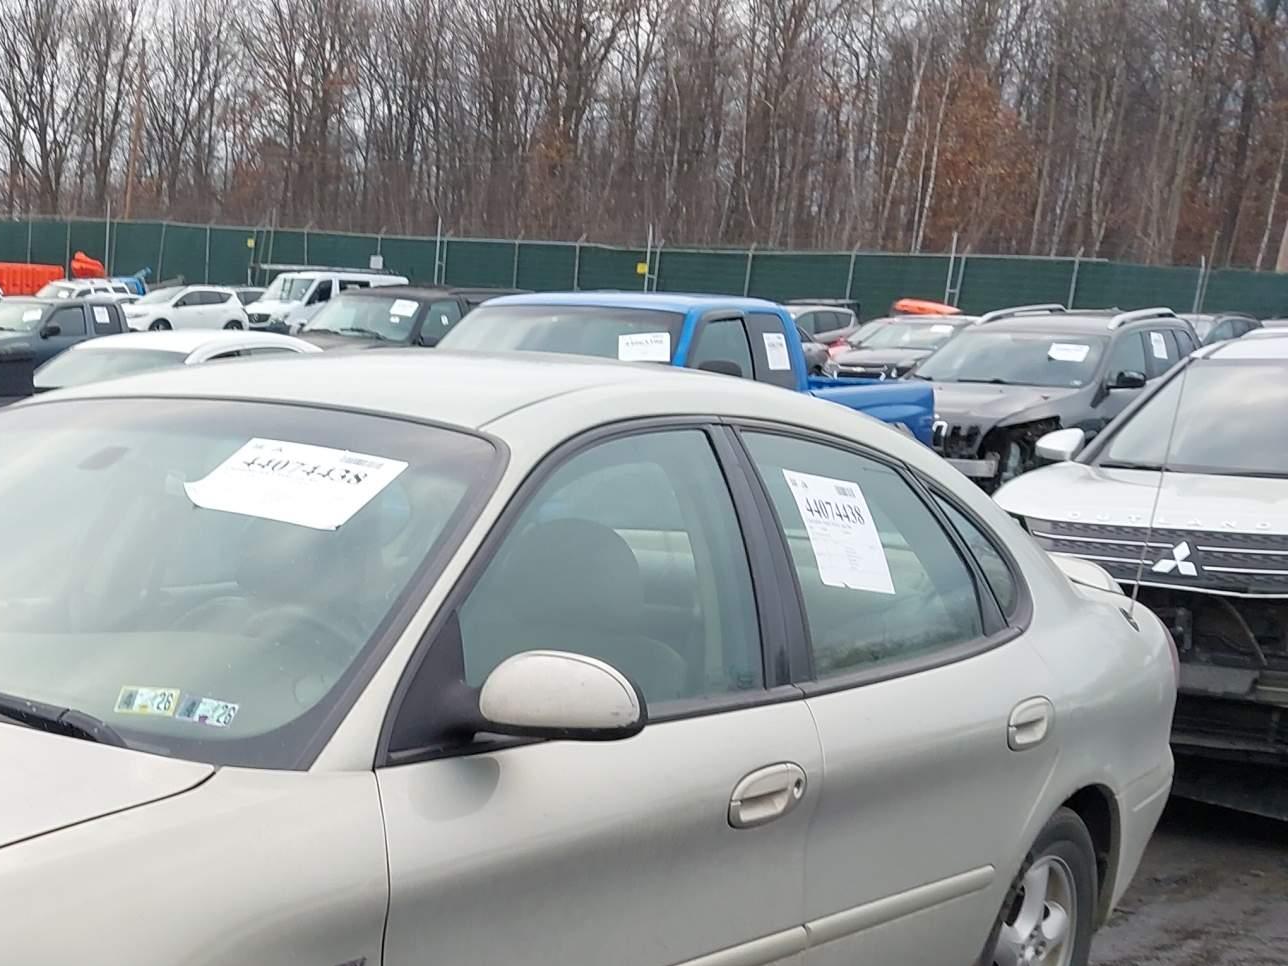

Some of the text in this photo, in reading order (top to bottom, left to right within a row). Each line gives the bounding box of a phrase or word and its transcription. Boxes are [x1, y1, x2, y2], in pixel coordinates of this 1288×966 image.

[243, 456, 368, 485] 44074438
[805, 497, 866, 525] 44074438
[156, 691, 174, 711] 26
[215, 704, 237, 725] 26
